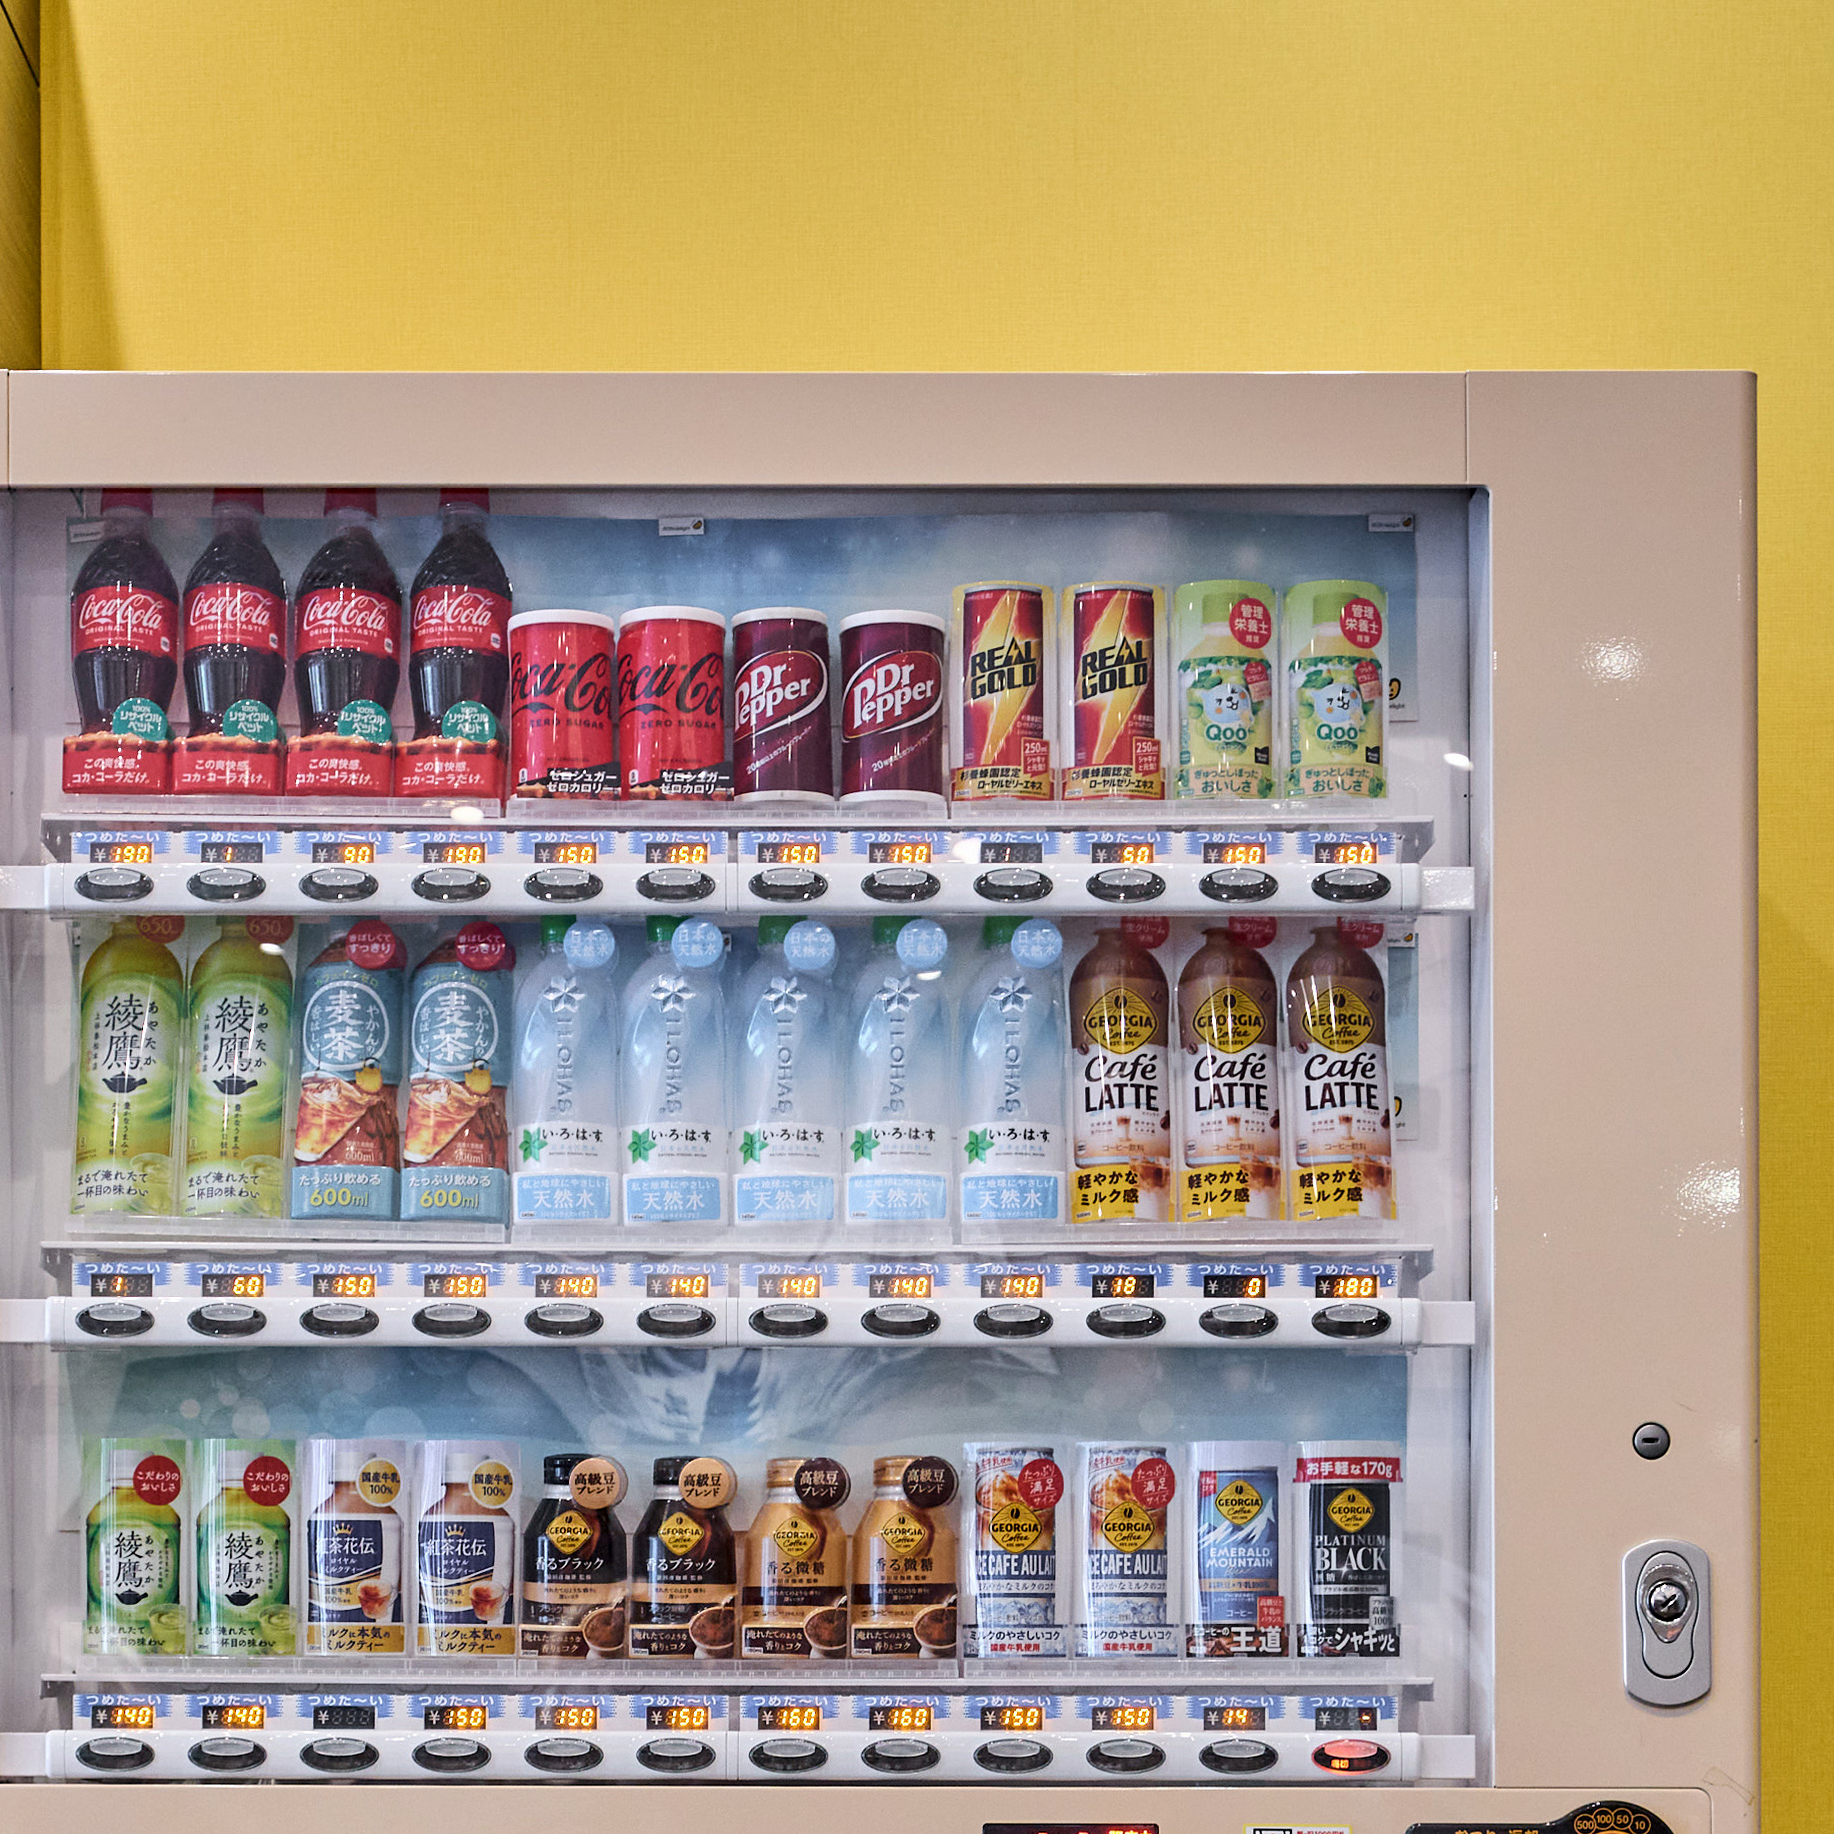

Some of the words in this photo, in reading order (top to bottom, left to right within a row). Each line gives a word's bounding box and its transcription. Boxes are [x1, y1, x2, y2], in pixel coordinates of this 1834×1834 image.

[79, 594, 165, 629] Coca-Cola
[190, 591, 273, 626] Coca-Cola
[1241, 605, 1263, 619] 管理
[309, 626, 349, 636] ORIGINAL
[353, 628, 378, 637] TASTE
[418, 624, 454, 635] ORIGINAL
[458, 625, 483, 633] TASTE
[1235, 619, 1268, 634] 栄養士
[971, 636, 1037, 677] REAL
[1082, 636, 1148, 677] REAL
[750, 664, 787, 699] Dr
[877, 663, 914, 696] Dr
[971, 663, 1037, 699] GOLD
[1082, 663, 1148, 700] GOLD
[735, 677, 811, 732] Pepper
[854, 678, 934, 729] Pepper
[121, 712, 161, 722] リサイクル
[229, 712, 269, 722] リサイクル
[641, 720, 672, 729] ZERO
[128, 722, 154, 733] ペット
[238, 722, 263, 732] ペット
[1206, 724, 1248, 741] Qoo
[1317, 724, 1359, 741] Qoo
[1202, 779, 1252, 793] おいしさ
[1313, 779, 1363, 793] おいしさ
[102, 994, 143, 1071] 綾鷹
[213, 995, 254, 1072] 綾鷹
[321, 991, 364, 1061] 麦茶
[432, 991, 473, 1062] 麦茶
[254, 1003, 269, 1068] あやたか
[1085, 1054, 1157, 1082] Café
[1194, 1052, 1267, 1082] Café
[1304, 1052, 1377, 1082] Café
[1085, 1082, 1159, 1112] LATTE
[1195, 1082, 1269, 1112] LATTE
[1305, 1081, 1379, 1112] LATTE
[1077, 1170, 1139, 1190] 軽やかな
[1188, 1169, 1249, 1189] 軽やかな
[310, 1188, 368, 1206] 600ml
[420, 1189, 479, 1208] 600ml
[533, 1190, 595, 1209] 天然水
[643, 1192, 705, 1210] 天然水
[1079, 1188, 1139, 1206] ミルク感
[1191, 1187, 1251, 1206] ミルク感
[137, 1471, 180, 1482] こだわりの
[1307, 1462, 1393, 1477] お手軽な170g
[361, 1472, 400, 1483] 国産牛乳
[474, 1474, 512, 1485] 国産牛乳
[574, 1472, 616, 1485] 高級豆
[683, 1473, 722, 1487] 高級豆
[370, 1484, 393, 1495] 100%
[577, 1485, 614, 1494] ブレンド
[909, 1485, 944, 1494] ブレンド
[1218, 1498, 1260, 1507] GEORGIA
[991, 1523, 1039, 1532] GEORGIA
[1104, 1523, 1152, 1532] GEORGIA
[1315, 1535, 1386, 1546] PLATINUM
[1210, 1547, 1270, 1557] EMERALD
[1315, 1547, 1386, 1571] BLACK
[535, 1557, 604, 1571] 香るブラック
[646, 1558, 716, 1572] 香るブラック
[767, 1562, 825, 1575] 香る微糖
[876, 1558, 933, 1572] 香る微糖
[990, 1555, 1020, 1575] CAFE
[1021, 1555, 1038, 1575] AU
[1206, 1557, 1273, 1568] MOUNTAIN
[1226, 1609, 1252, 1617] コーヒー
[991, 1643, 1040, 1652] 国産牛乳使用
[1577, 1821, 1594, 1829] 500
[1596, 1814, 1612, 1823] 100
[1616, 1814, 1629, 1824] 50
[1635, 1821, 1645, 1829] 10
